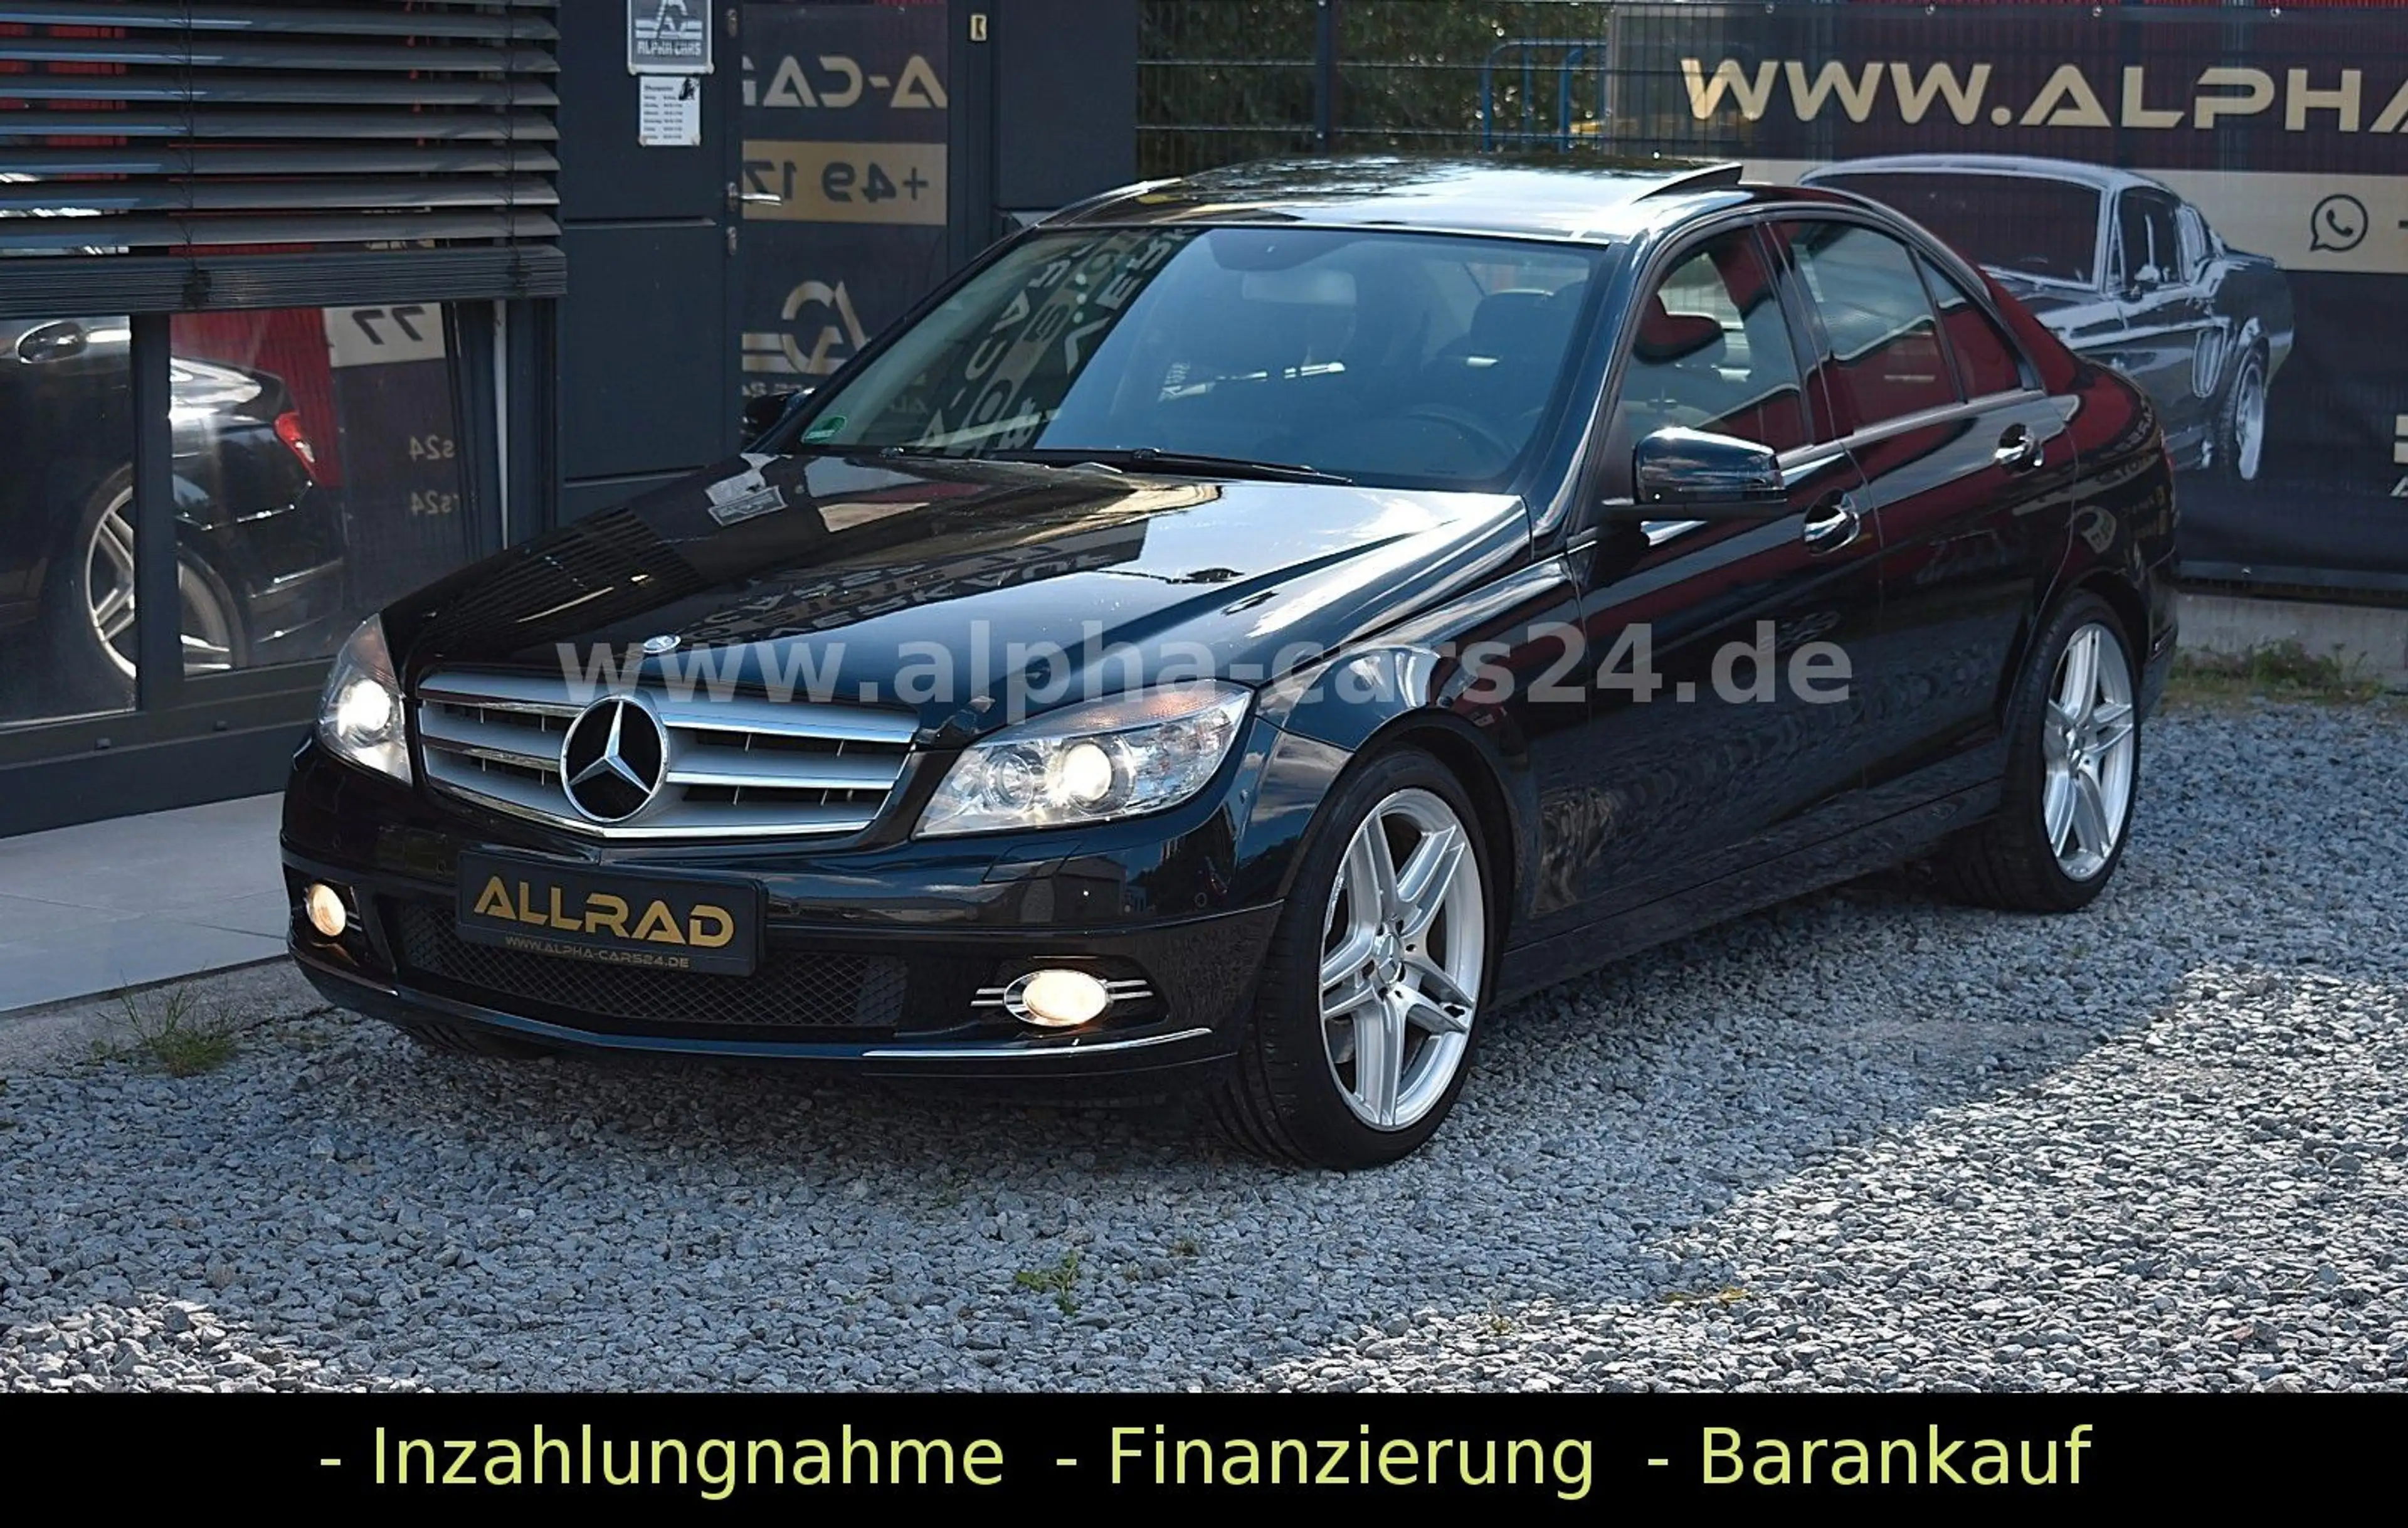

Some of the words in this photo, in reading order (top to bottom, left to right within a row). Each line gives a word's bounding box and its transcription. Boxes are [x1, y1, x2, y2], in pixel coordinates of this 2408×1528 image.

[636, 40, 673, 55] ALPHA
[674, 41, 702, 56] CARS
[473, 876, 735, 948] ALLRAD
[505, 935, 690, 968] WWW.ALPHA-CARS24.DE
